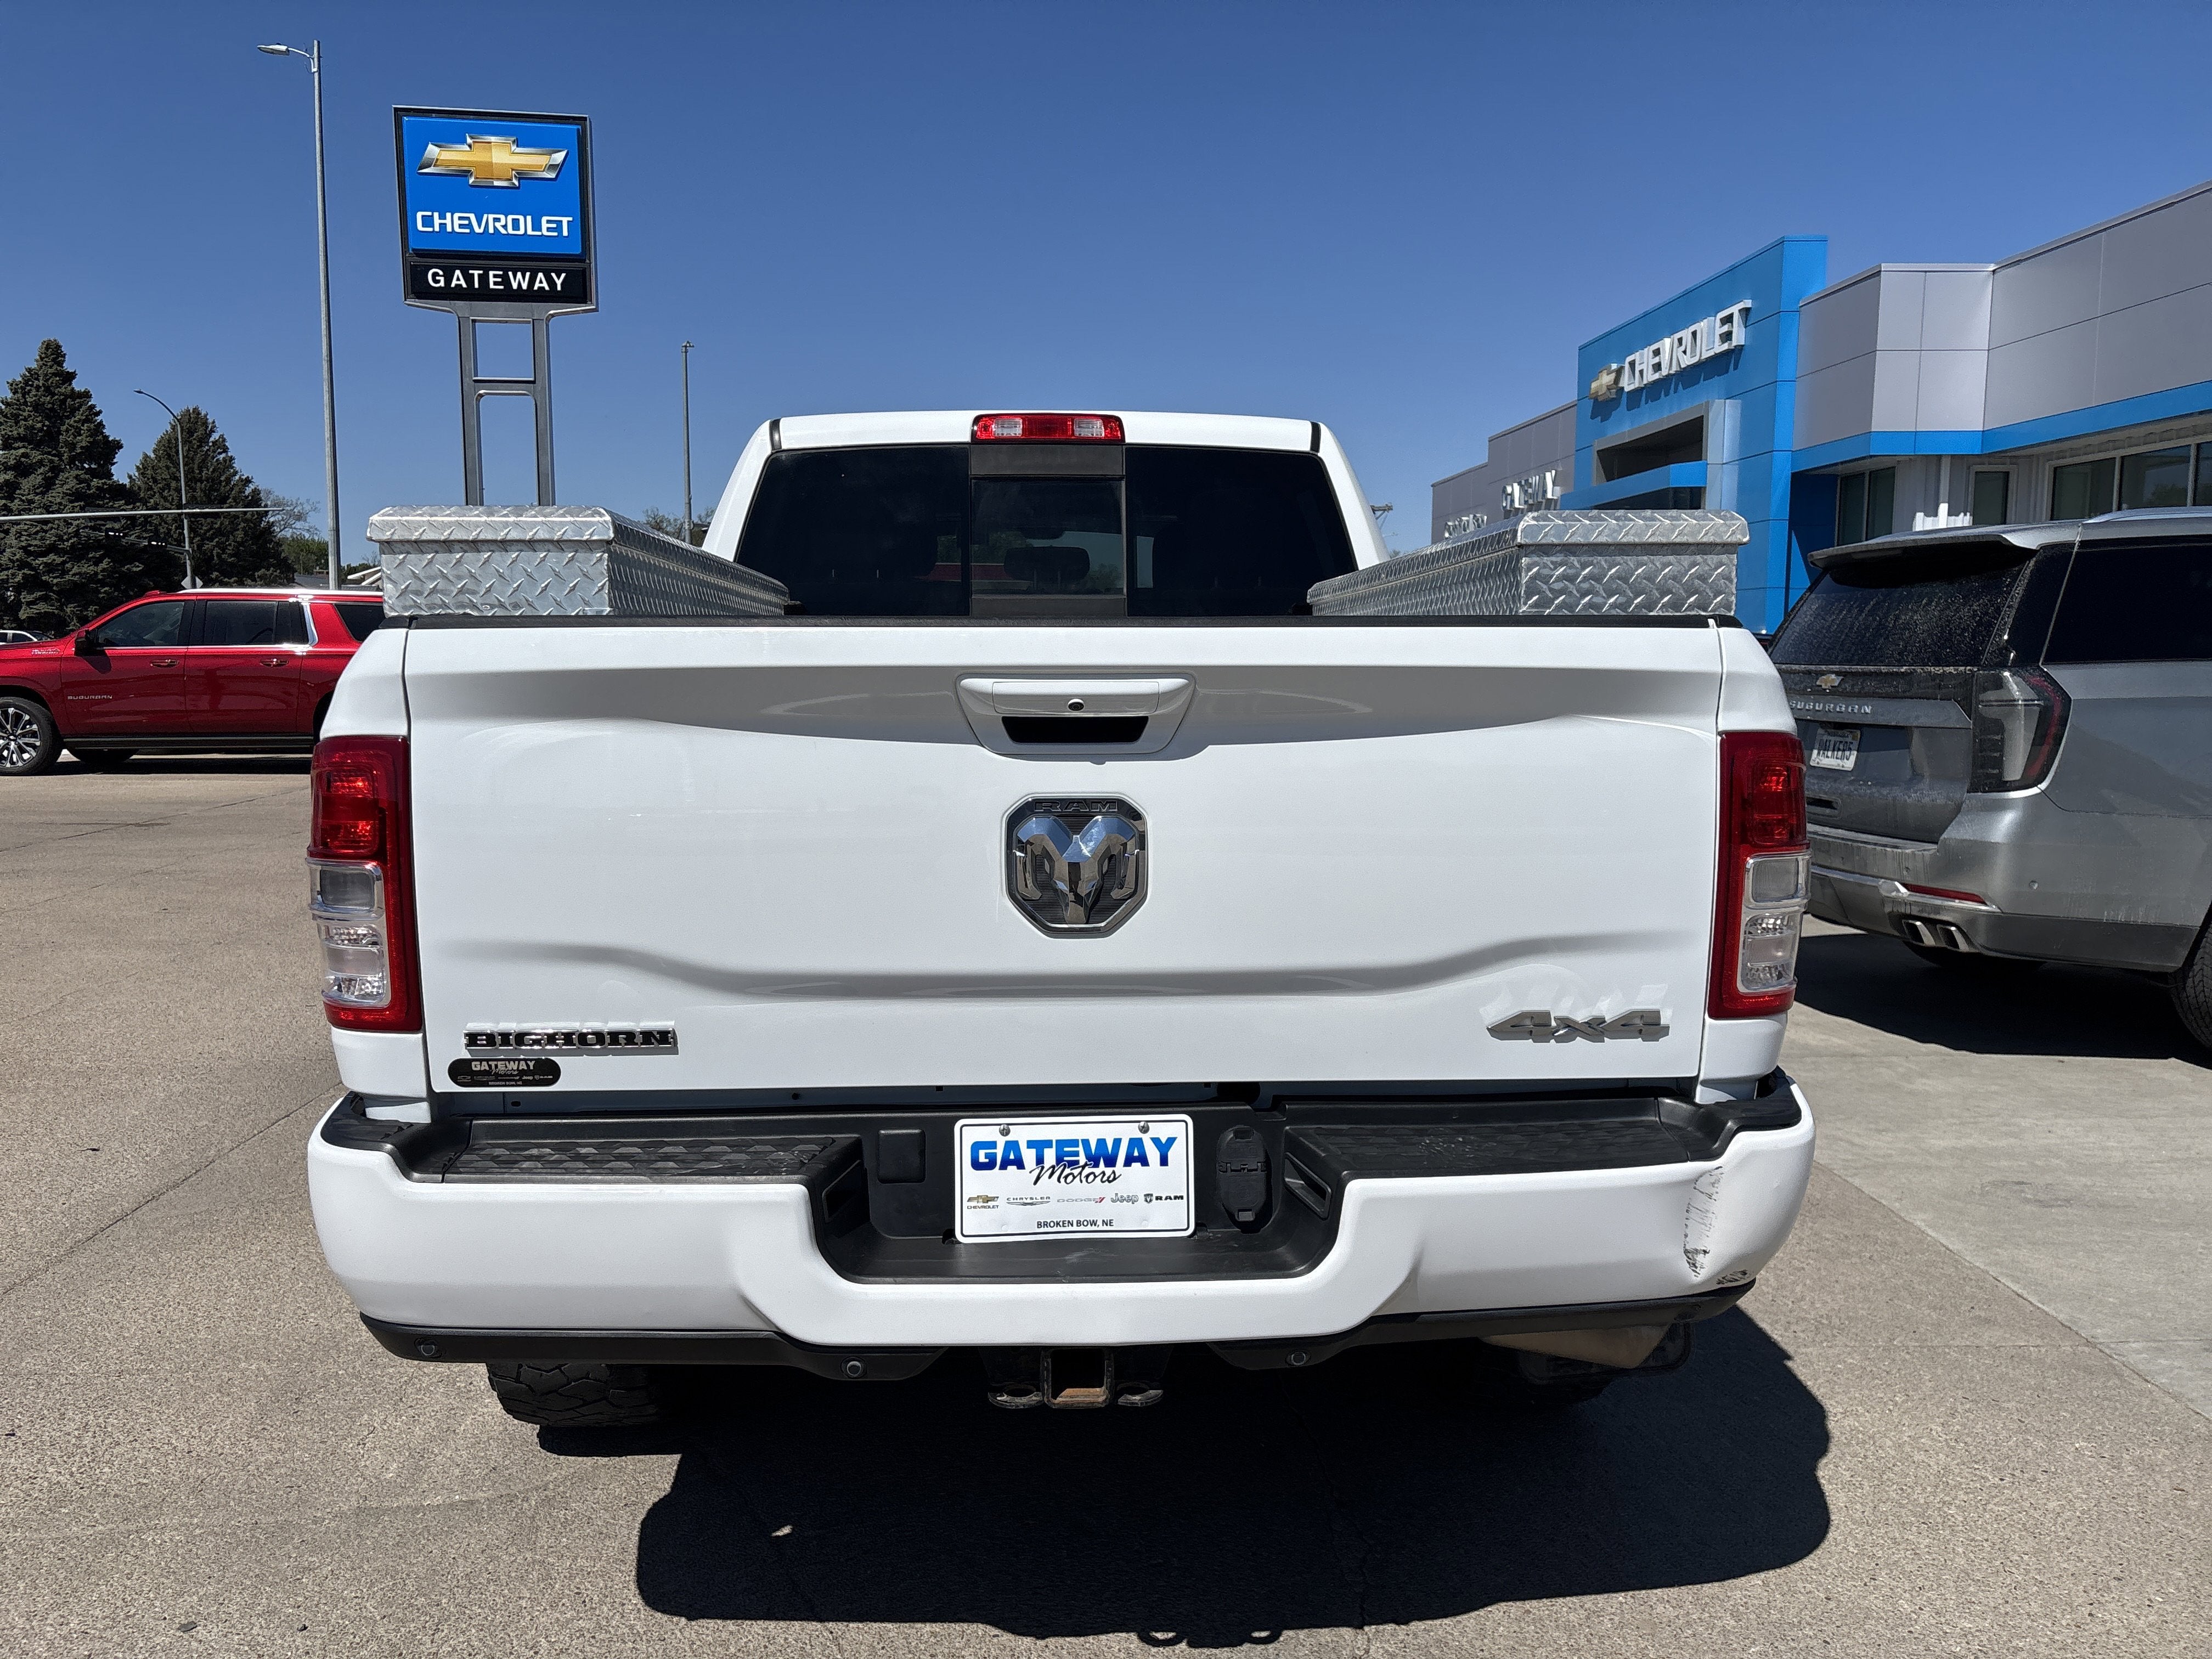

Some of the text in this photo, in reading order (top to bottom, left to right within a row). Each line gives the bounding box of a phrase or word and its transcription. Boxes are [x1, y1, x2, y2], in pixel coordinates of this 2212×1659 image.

[416, 211, 573, 236] CHEVROLET
[427, 268, 567, 291] GATEWAY
[1624, 299, 1752, 392] CHEVROLET
[1789, 701, 1872, 714] SUBURBAN
[1035, 800, 1118, 812] RAM
[1486, 1008, 1670, 1041] 4x4
[462, 1029, 675, 1049] BIGHORN
[471, 1060, 535, 1070] GATEWAY
[970, 1137, 1178, 1171] GATEWAY
[1029, 1161, 1122, 1186] Motors
[1110, 1193, 1139, 1205] Jeep
[1036, 1218, 1114, 1229] BROKEN BOW, NE
